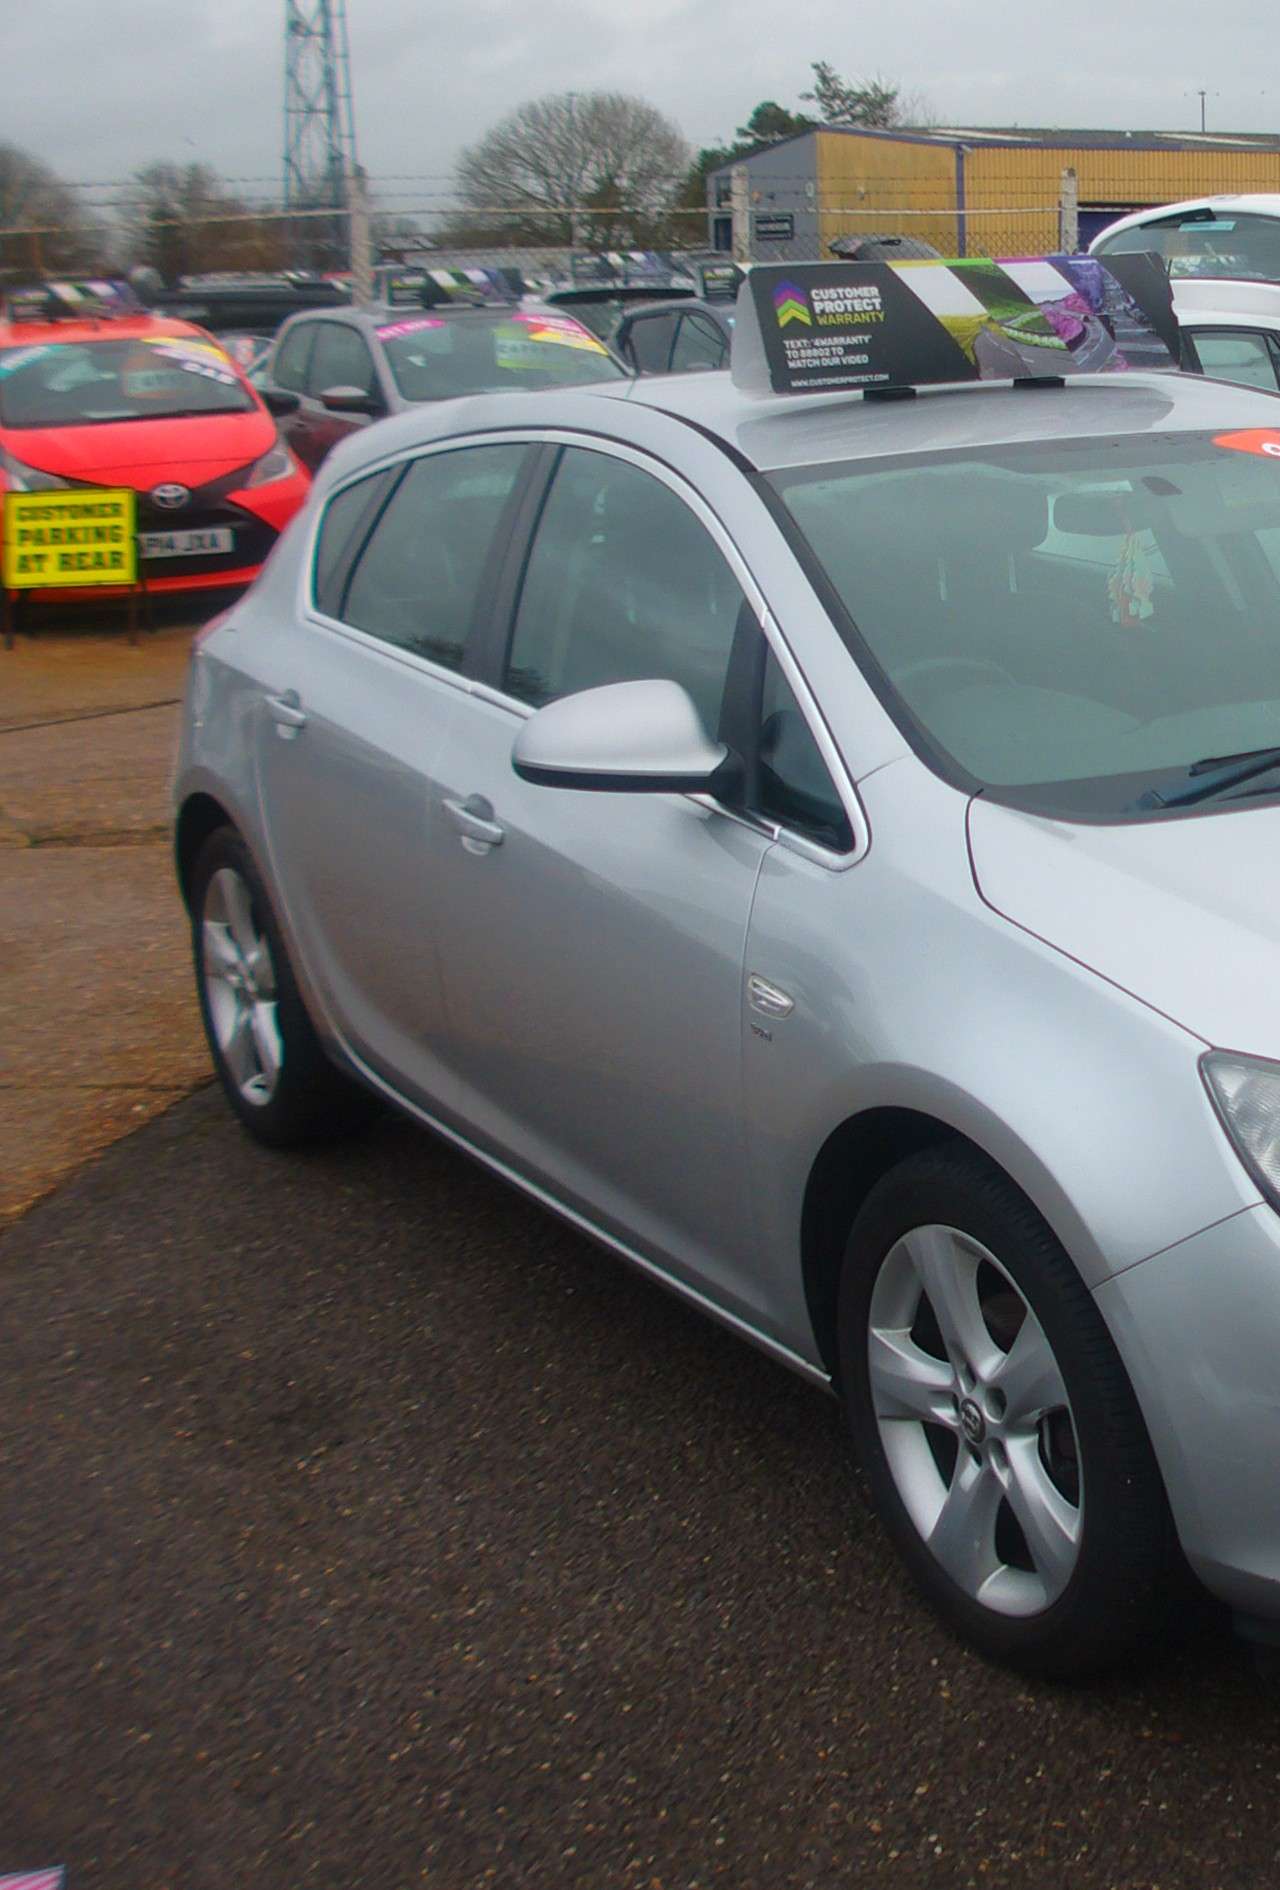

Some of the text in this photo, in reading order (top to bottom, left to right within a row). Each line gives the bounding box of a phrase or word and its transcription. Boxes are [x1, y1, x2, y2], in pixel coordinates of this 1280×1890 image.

[810, 286, 880, 301] CUSTOMER
[812, 298, 883, 314] PROTECT
[815, 312, 886, 326] WARRANTY
[832, 346, 844, 356] TO
[787, 355, 869, 369] WATCH OUR VIDEO
[16, 503, 124, 522] CUSTOMER
[17, 525, 124, 547] PARKING
[16, 550, 126, 574] AT REAR
